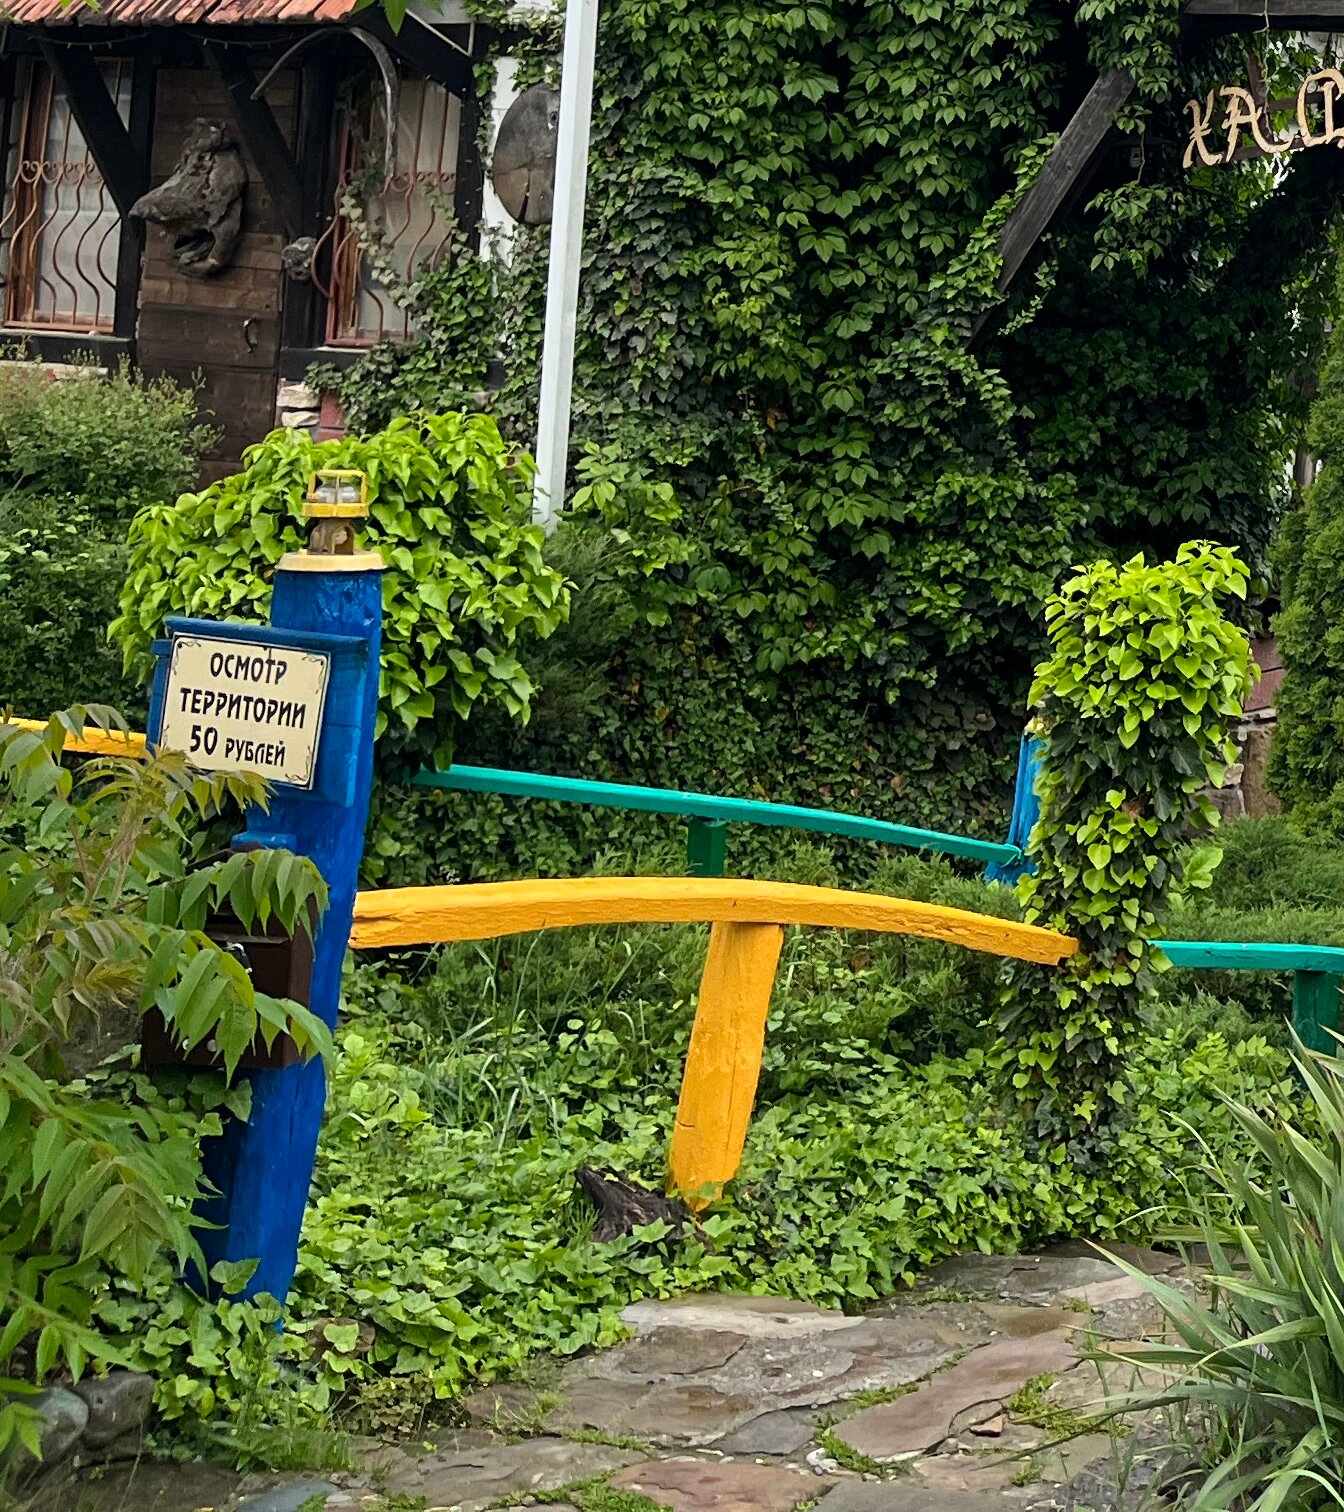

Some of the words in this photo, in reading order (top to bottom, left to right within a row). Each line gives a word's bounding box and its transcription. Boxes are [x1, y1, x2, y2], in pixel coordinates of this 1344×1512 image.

[210, 652, 287, 685] ОСМОТР
[180, 687, 306, 729] ТЕРРИТОРИИ
[190, 725, 218, 755] 50
[225, 738, 286, 767] РУБЛЕЙ
